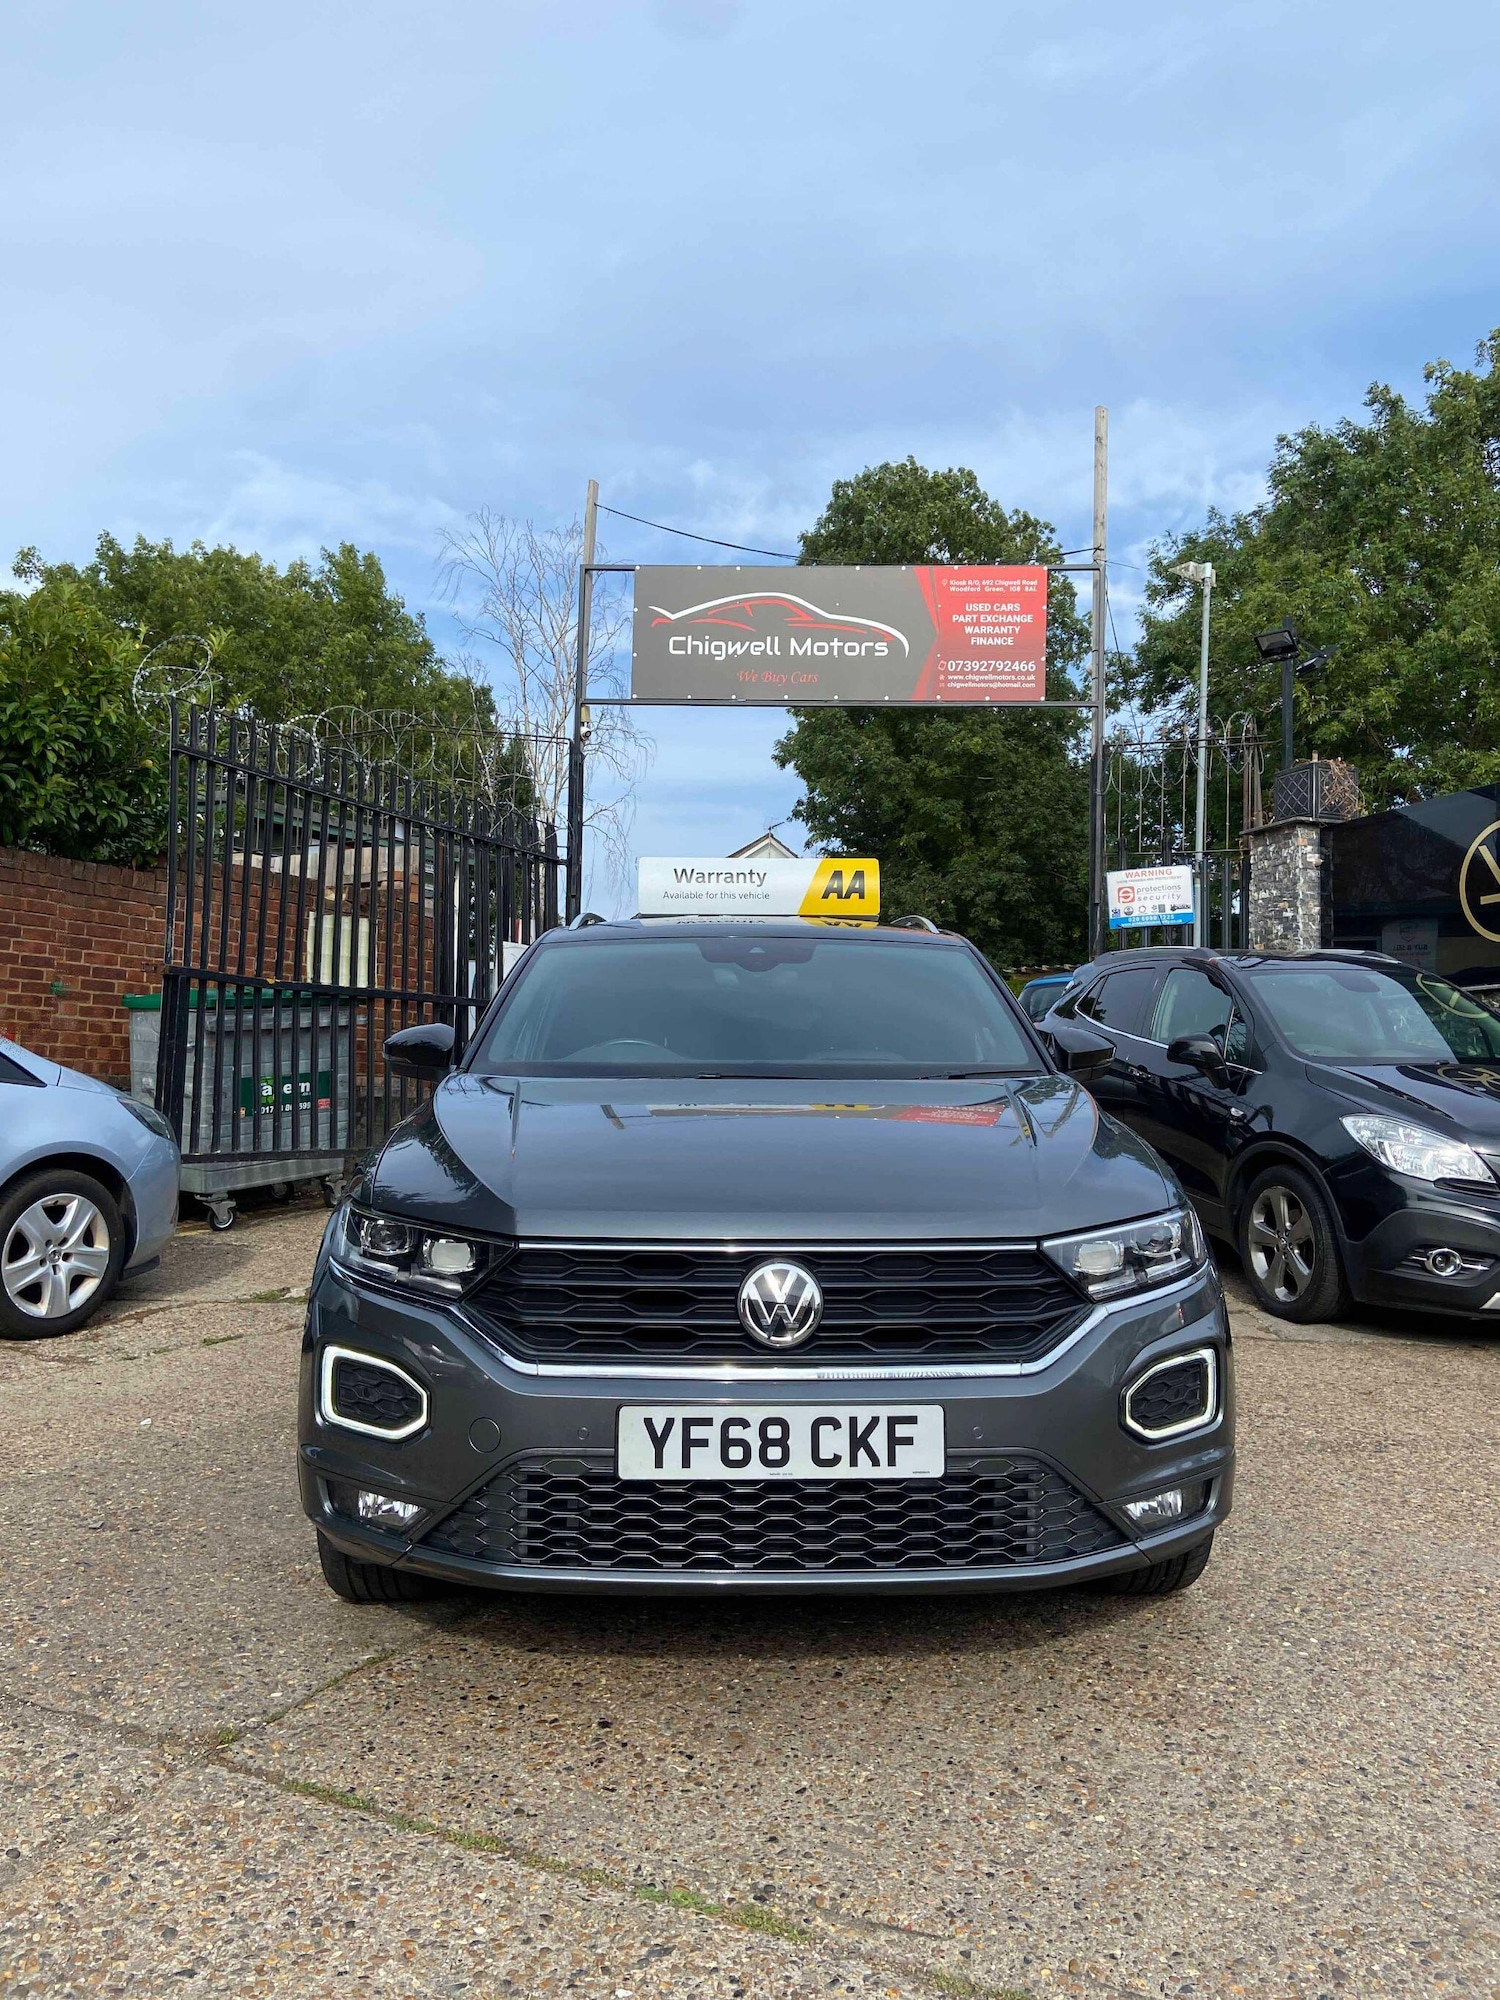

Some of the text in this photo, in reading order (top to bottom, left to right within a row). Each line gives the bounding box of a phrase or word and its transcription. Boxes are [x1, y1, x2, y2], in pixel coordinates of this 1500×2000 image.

[995, 579, 1020, 587] Chigwell
[966, 603, 1020, 612] USED CARS
[952, 614, 1033, 622] PART EXCHANGE
[964, 626, 1021, 634] WARRANTY
[971, 637, 1014, 645] FINANCE
[669, 635, 889, 660] Chigwell Motors
[948, 660, 1036, 672] 07392792466
[737, 669, 819, 686] We Buy Cars
[673, 868, 767, 887] Warranty
[1125, 868, 1172, 878] WARNING
[821, 870, 865, 899] AA
[1137, 884, 1182, 894] protections
[662, 890, 770, 900] Available for this vehicle
[1137, 894, 1182, 902] security
[643, 1415, 918, 1469] YF68 CKF
